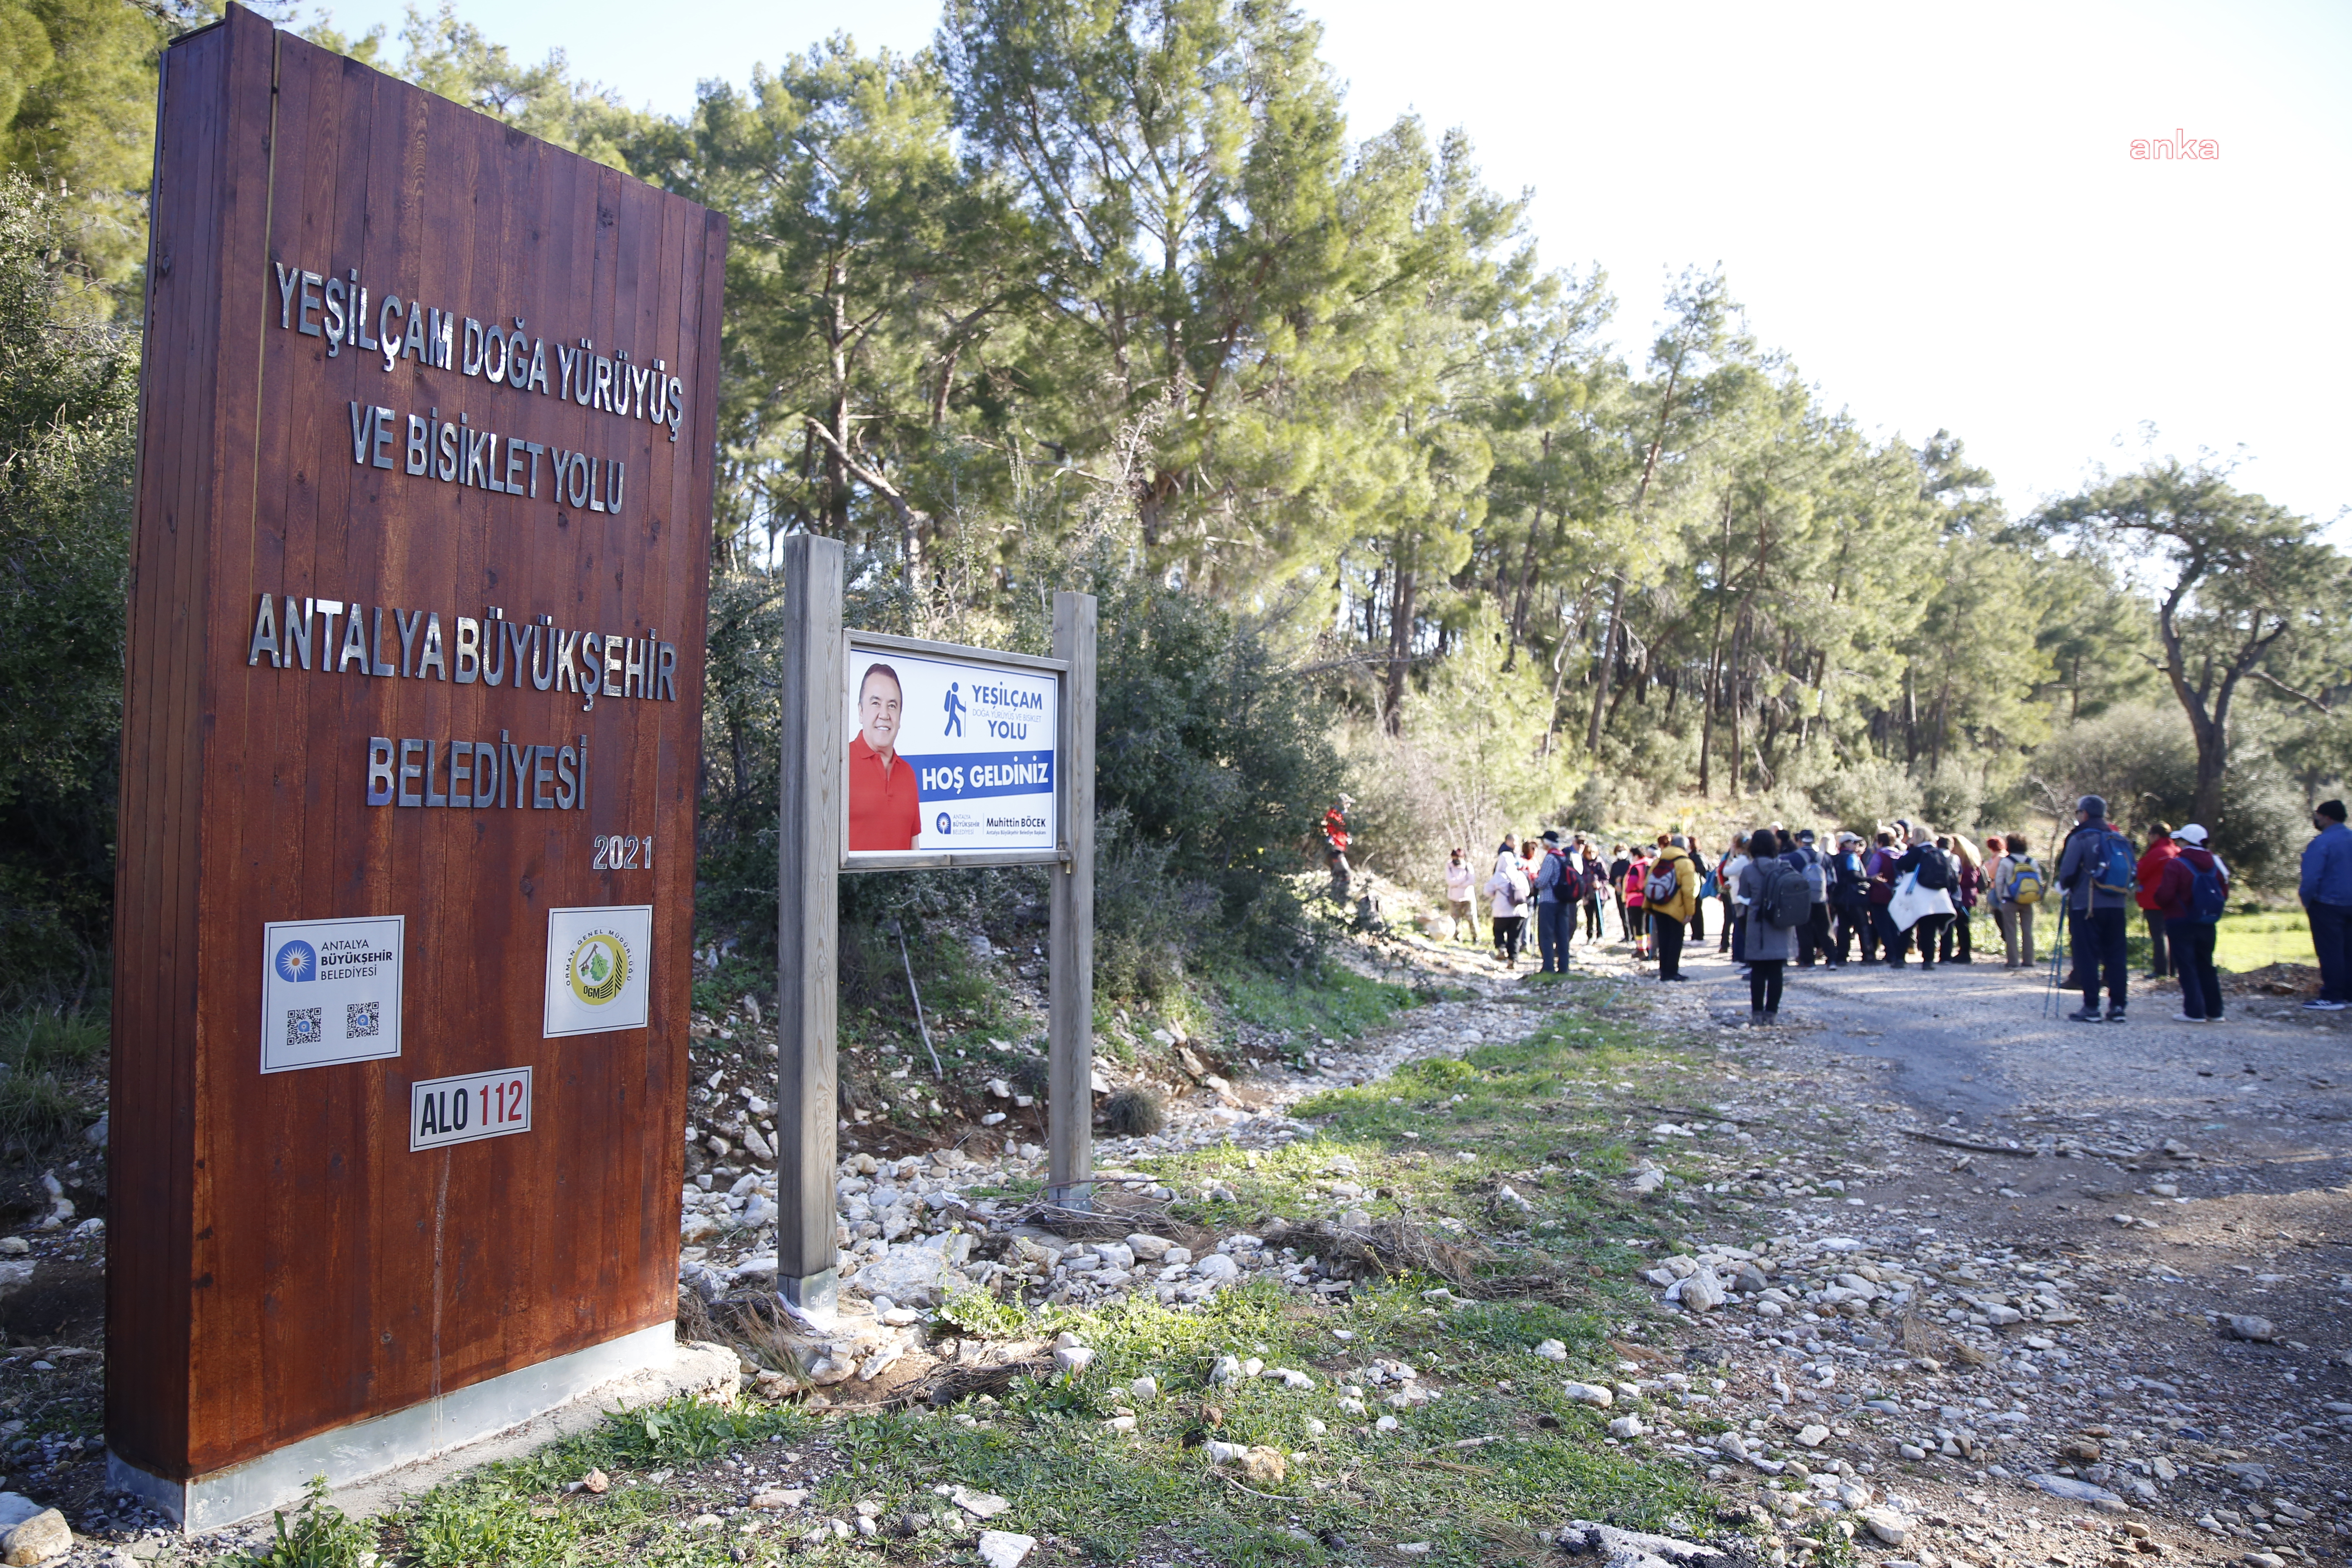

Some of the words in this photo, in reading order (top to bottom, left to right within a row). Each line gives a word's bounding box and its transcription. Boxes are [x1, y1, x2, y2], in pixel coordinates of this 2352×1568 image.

[275, 262, 453, 372] YEŞİLÇAM
[463, 316, 549, 394] DOĞA
[556, 337, 683, 441] YÜRÜYÜŞ
[351, 401, 395, 469] VE
[406, 407, 543, 498] BİSİKLET
[550, 447, 624, 514] YOLU
[248, 593, 446, 681] ANTALYA
[455, 606, 677, 711] BÜYÜKŞEHİR
[972, 682, 1042, 711] YEŞİLÇAM
[973, 708, 989, 717] DOĞA
[991, 709, 1014, 720] YÜRÜYÜŞ
[987, 720, 1027, 740] YOLU
[367, 729, 587, 810] BELEDİYESİ
[922, 766, 964, 795] HOŞ
[969, 756, 1049, 788] GELDİNİZ
[987, 817, 1019, 827] Muhittin
[1021, 816, 1046, 827] BÖCEK
[593, 835, 652, 869] 2021
[321, 939, 369, 951] ANTALYA
[321, 949, 393, 966] BÜYÜKŞEHİR
[566, 950, 575, 986] ORMAN
[577, 929, 603, 945] GENEL
[608, 930, 634, 981] MÜDÜRLÜĞÜ
[321, 964, 376, 980] BELEDİYESİ
[584, 986, 600, 999] OGM
[421, 1088, 468, 1137] ALO
[479, 1080, 523, 1126] 112
